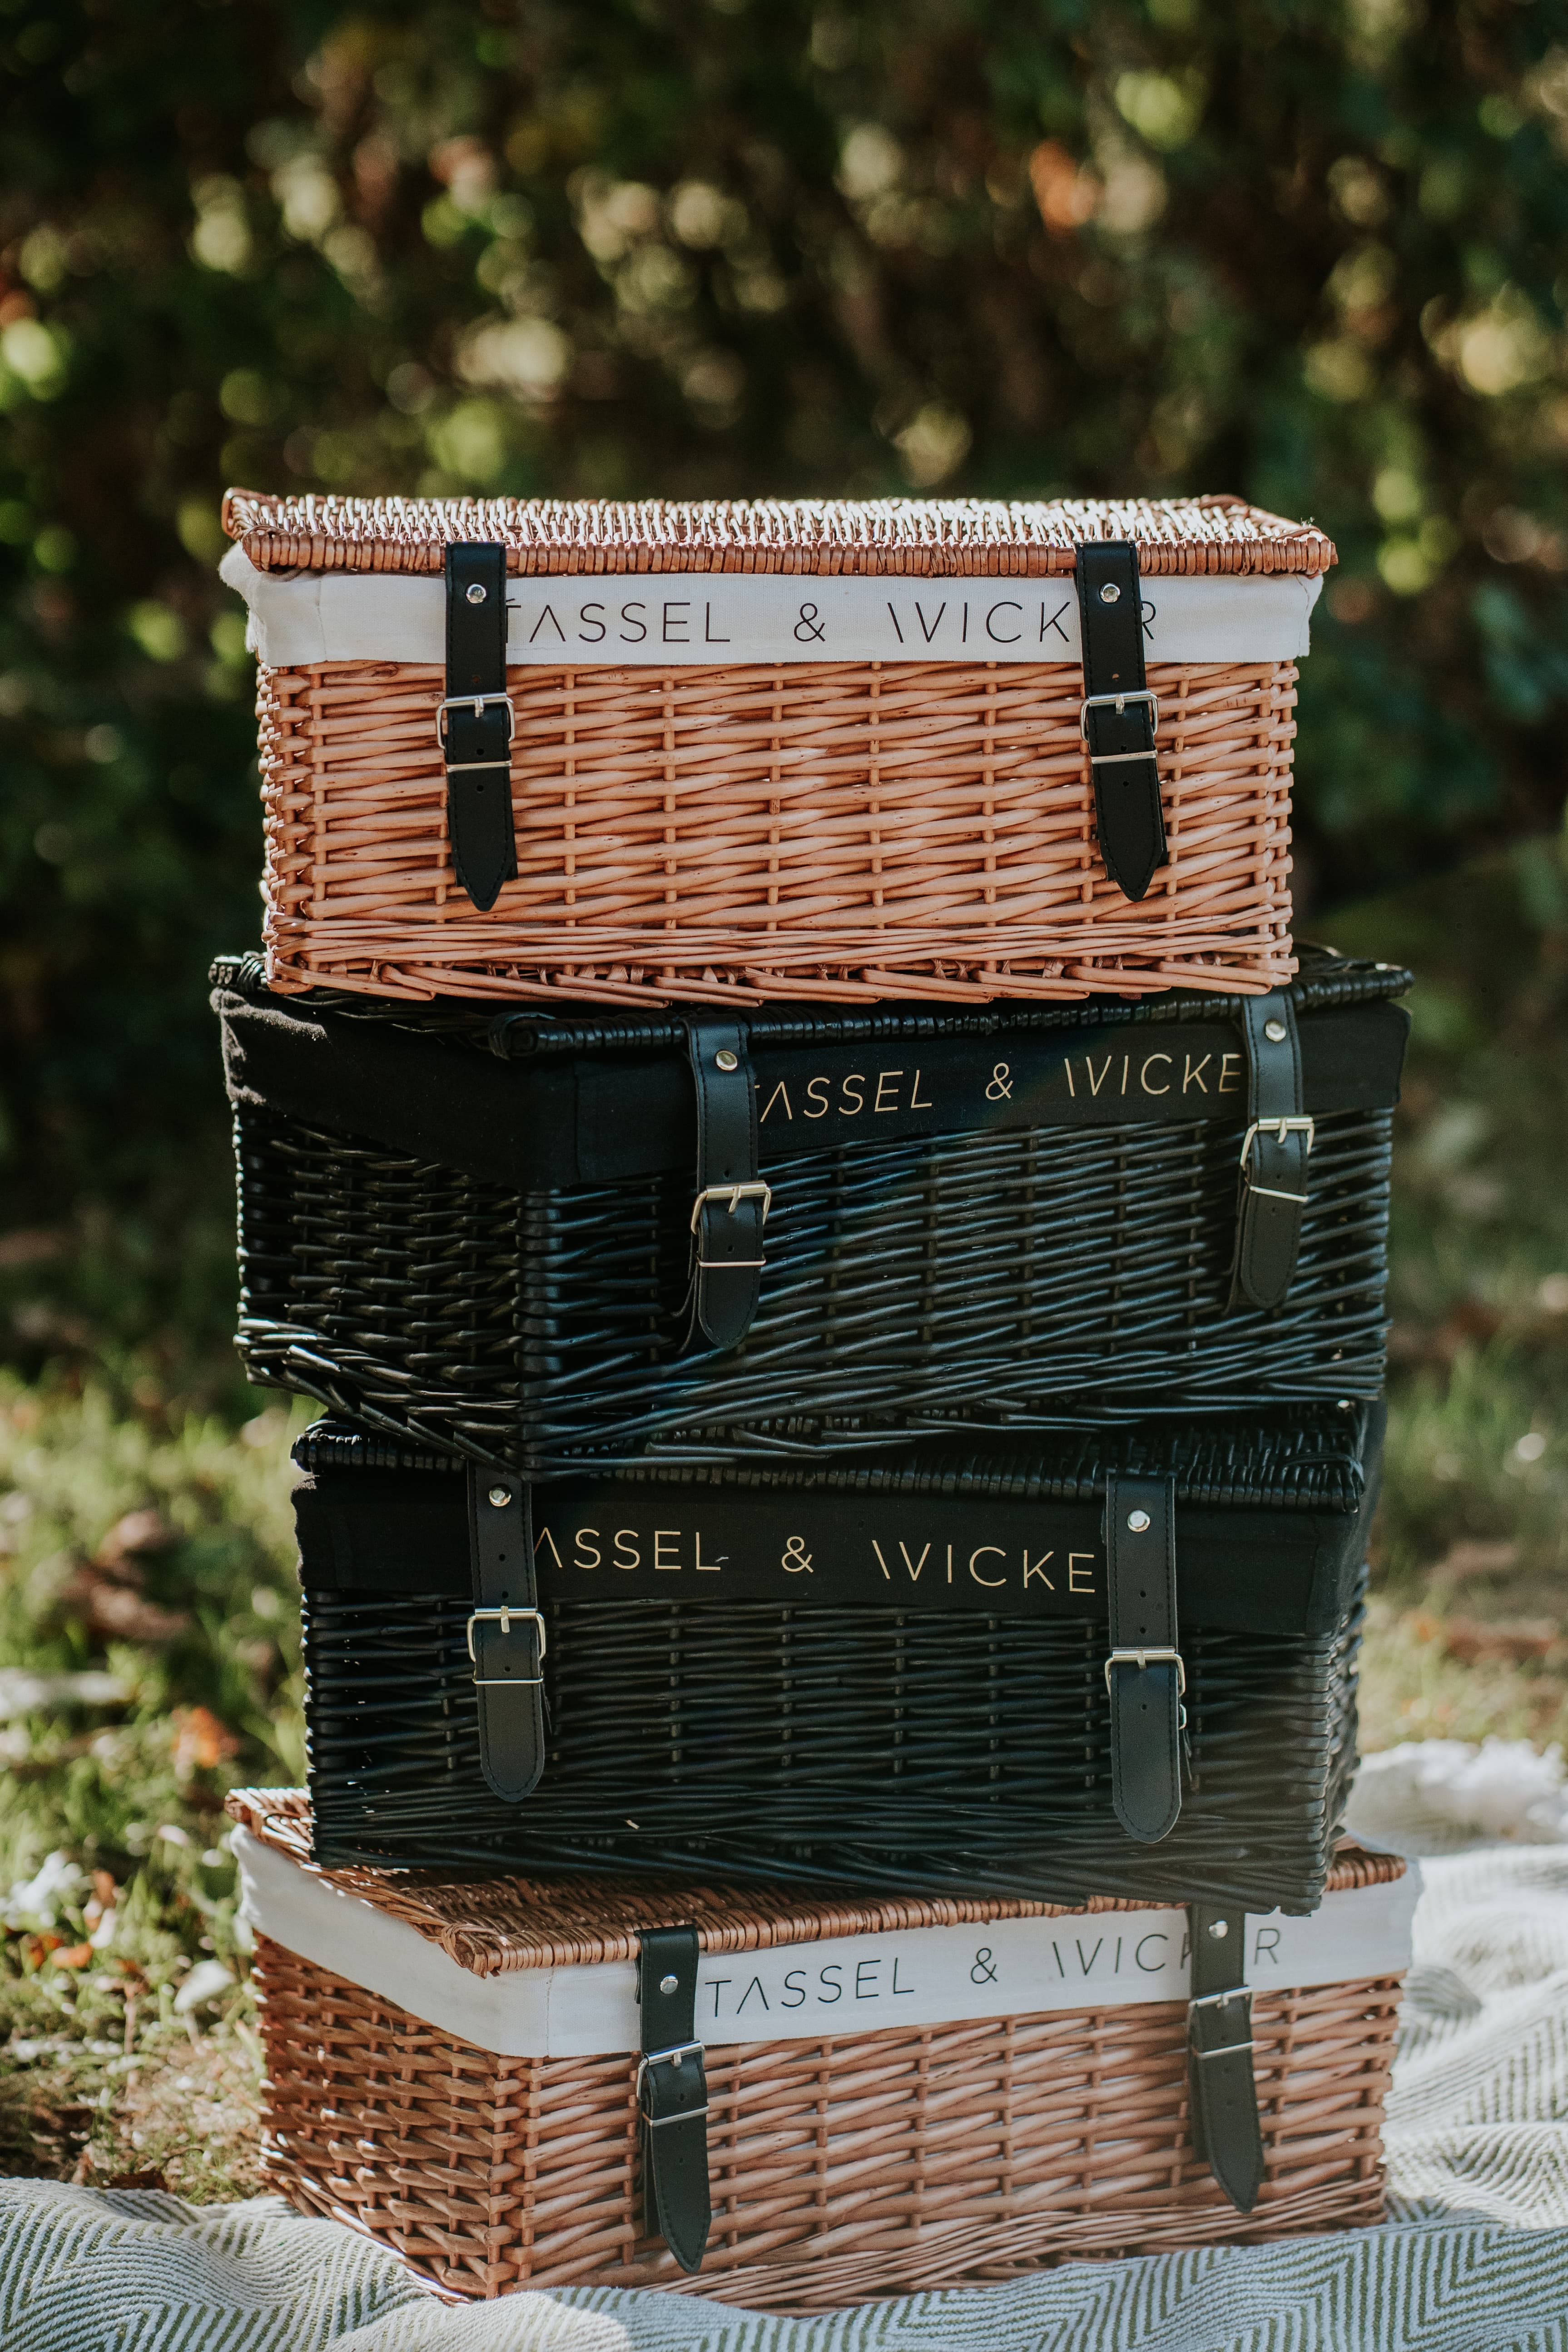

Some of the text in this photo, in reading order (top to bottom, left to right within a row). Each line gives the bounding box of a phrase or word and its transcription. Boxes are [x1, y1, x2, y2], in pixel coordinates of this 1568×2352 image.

[505, 601, 1156, 644] TASSEL & WICKR
[754, 1053, 1242, 1122] ASSEL & WICKE
[533, 1527, 1096, 1593] ASSEL & WICKE
[705, 1957, 915, 2017] TASSEL
[971, 1947, 998, 1985] &
